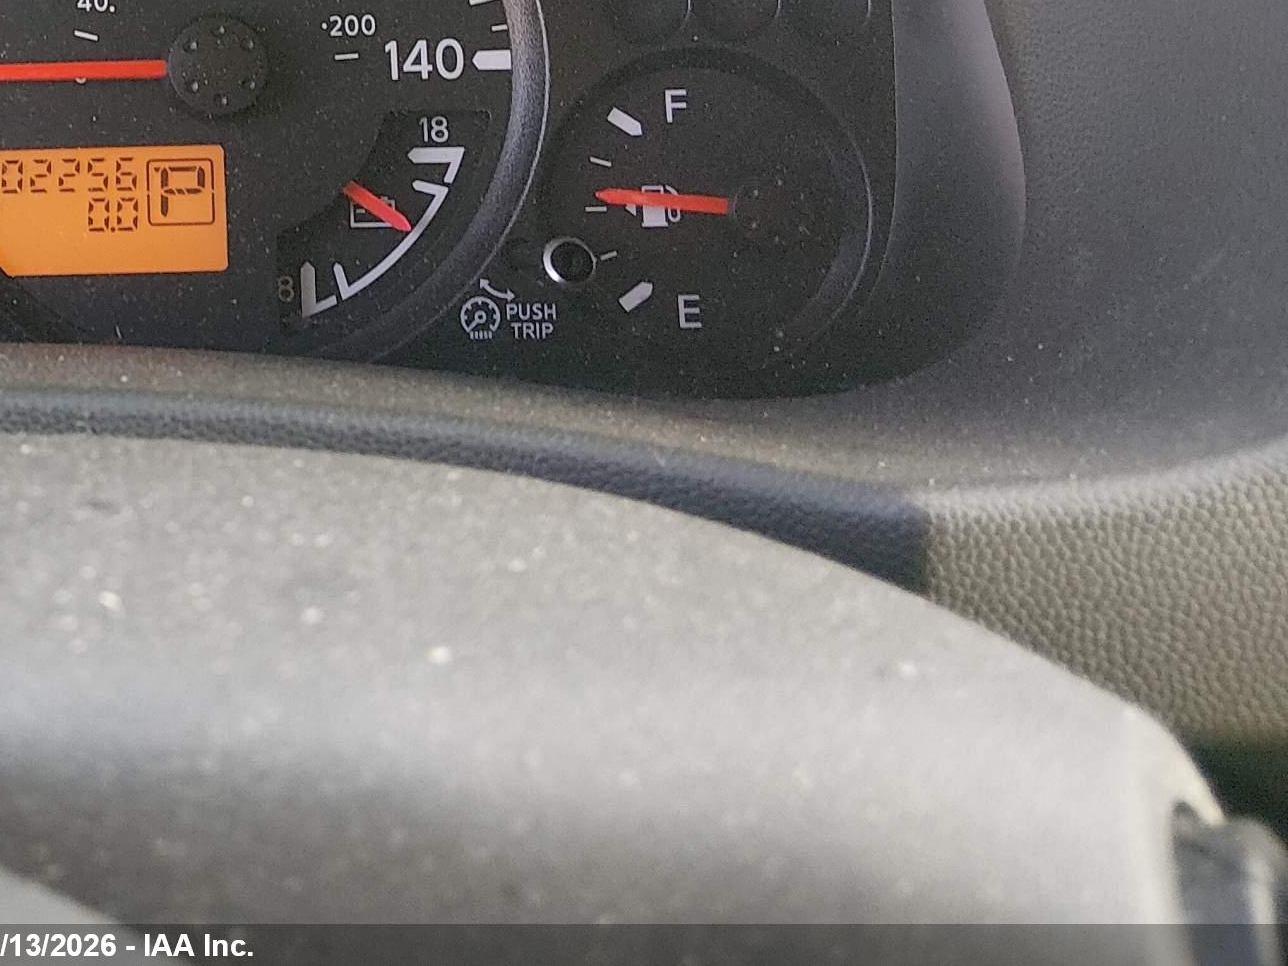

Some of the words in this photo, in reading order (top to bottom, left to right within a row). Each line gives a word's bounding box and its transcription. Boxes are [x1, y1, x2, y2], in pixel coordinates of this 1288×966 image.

[329, 15, 376, 37] 200
[384, 39, 465, 81] 140
[665, 88, 688, 124] F
[419, 116, 449, 143] 18
[154, 165, 206, 218] P
[277, 277, 295, 303] 8
[506, 303, 557, 322] PUSH
[678, 294, 703, 329] E
[510, 321, 554, 340] TRIP
